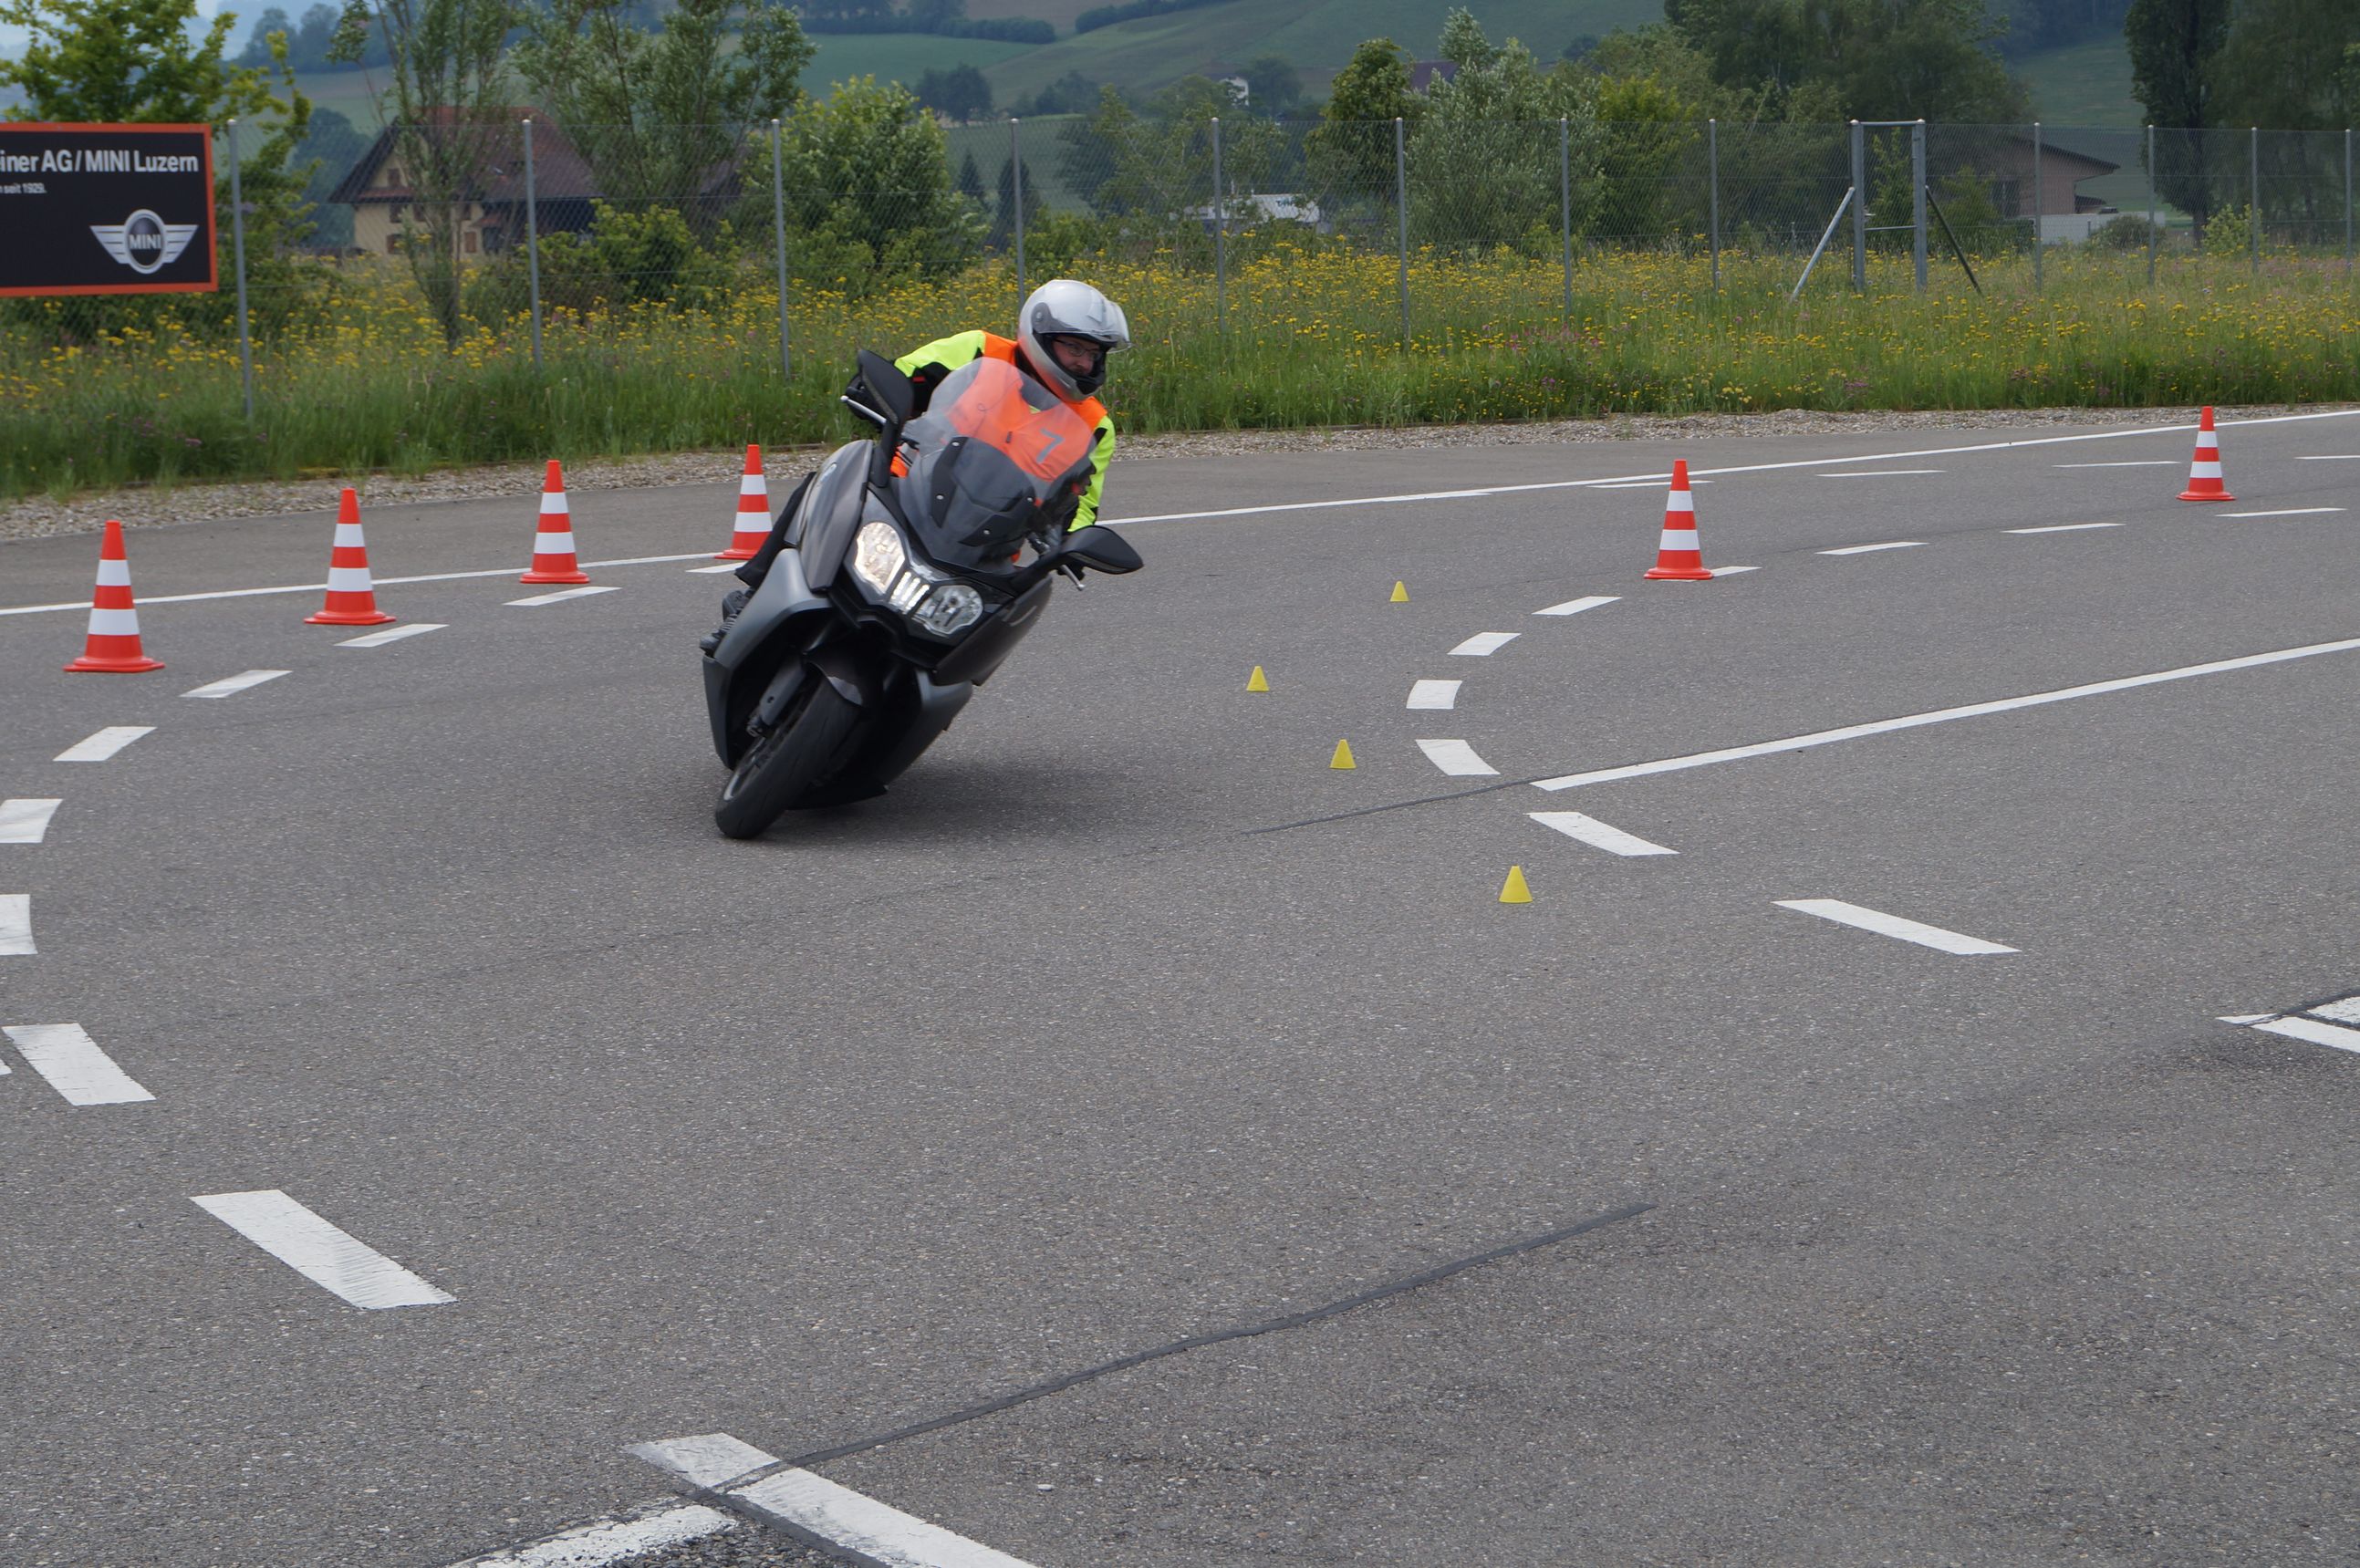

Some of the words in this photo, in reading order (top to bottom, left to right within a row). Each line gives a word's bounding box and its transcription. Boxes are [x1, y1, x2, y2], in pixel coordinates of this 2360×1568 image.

[85, 150, 130, 172] MINI
[133, 150, 200, 172] Luzern
[129, 234, 162, 250] MINI
[1035, 427, 1066, 464] 7
